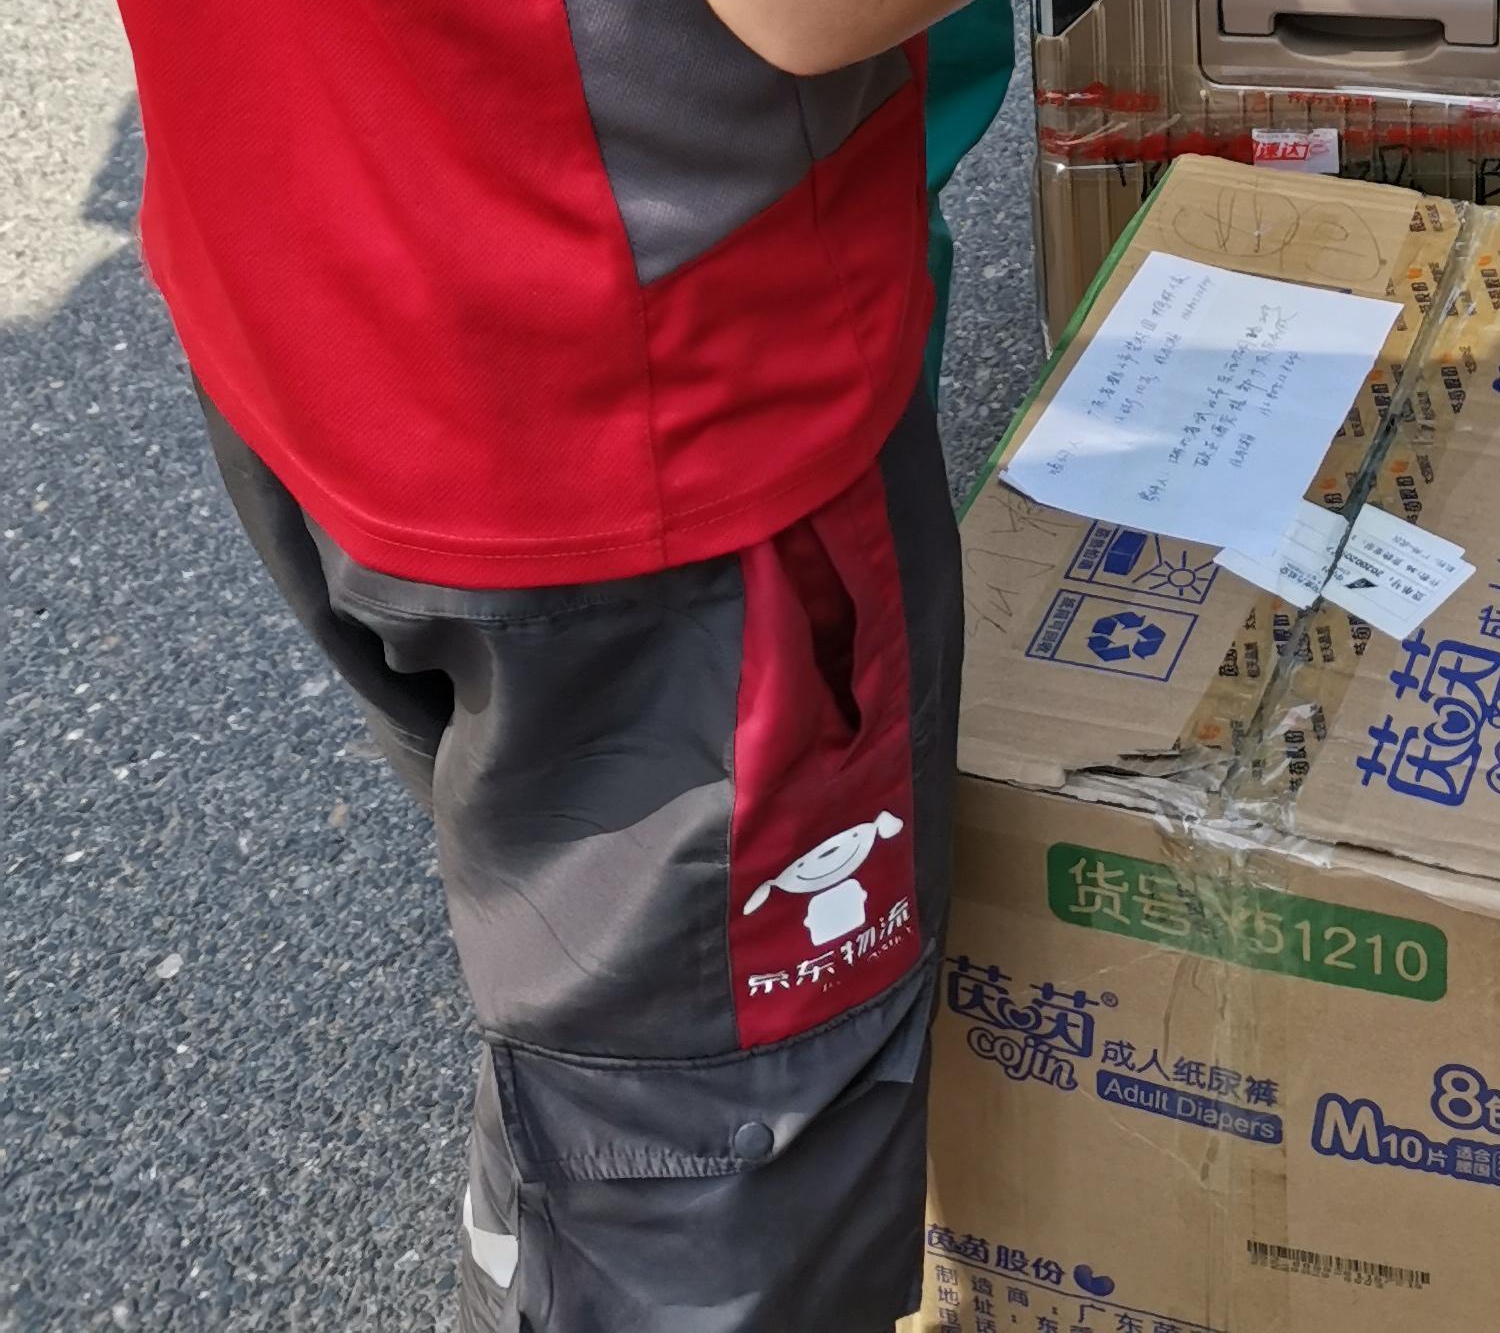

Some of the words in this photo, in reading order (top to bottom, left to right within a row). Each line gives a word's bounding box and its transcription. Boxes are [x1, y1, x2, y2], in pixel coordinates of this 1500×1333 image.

[1100, 1039, 1280, 1108] 成人纸尿裤
[1103, 1077, 1169, 1113] Adult
[1176, 1094, 1276, 1140] Diapers
